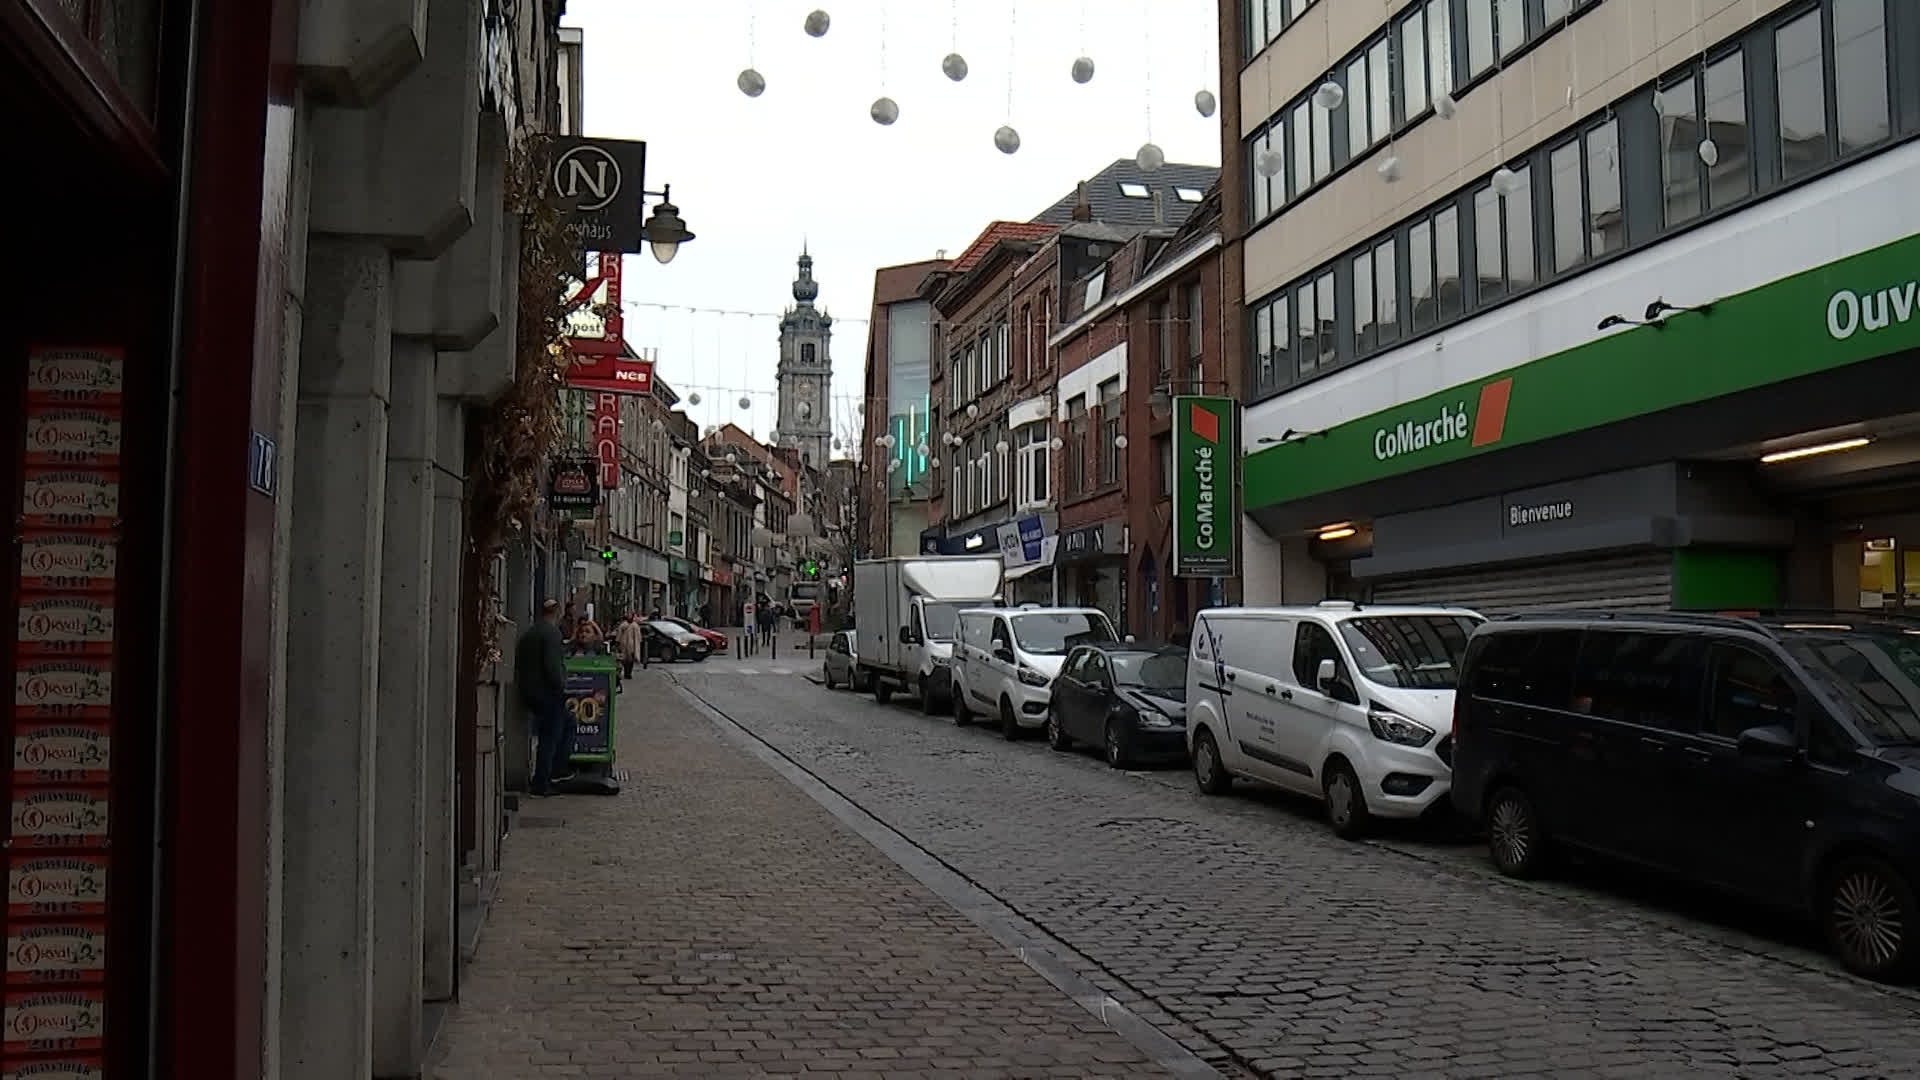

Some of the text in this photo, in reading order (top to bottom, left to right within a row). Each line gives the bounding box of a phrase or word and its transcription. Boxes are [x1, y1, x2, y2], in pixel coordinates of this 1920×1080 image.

[567, 159, 608, 199] N
[1827, 281, 1920, 340] Ouv
[1375, 401, 1469, 461] CoMarché
[1196, 446, 1214, 549] CoMarché
[1509, 501, 1574, 525] Bienvenue
